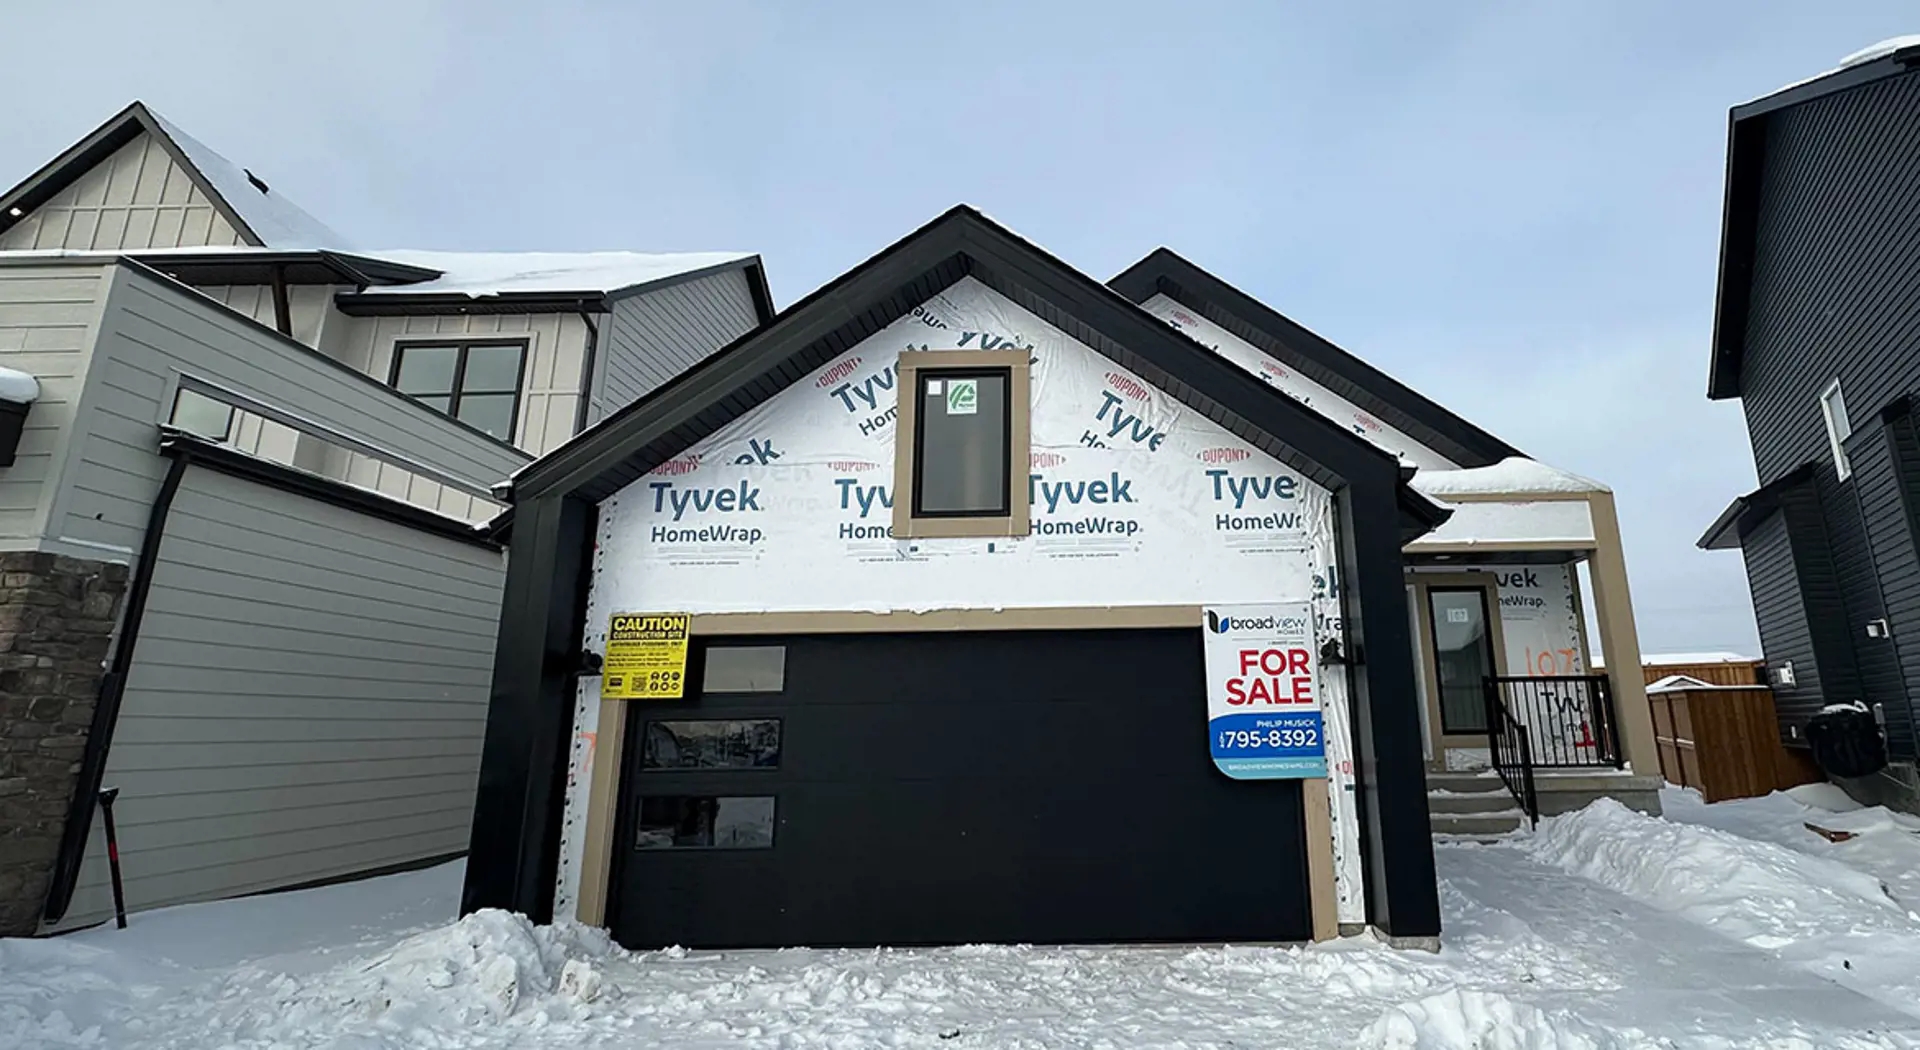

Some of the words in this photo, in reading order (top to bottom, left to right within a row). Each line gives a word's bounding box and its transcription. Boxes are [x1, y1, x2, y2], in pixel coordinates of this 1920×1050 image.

[820, 358, 858, 387] DUPONT
[830, 360, 899, 412] Tyv
[1109, 373, 1148, 401] DUPONT
[1202, 448, 1245, 463] DUPONT
[649, 480, 760, 521] Tyvek
[1029, 472, 1133, 514] Tyvek
[651, 525, 762, 545] HomeWrap
[1029, 517, 1138, 537] HomeWrap
[613, 617, 685, 631] CAUTION
[1230, 615, 1306, 630] broadview
[613, 631, 666, 639] CONSTRUCTION
[667, 631, 683, 639] SITE
[1239, 648, 1311, 677] FOR
[1226, 677, 1313, 706] SALE
[1256, 719, 1281, 728] PHILIP
[1284, 718, 1316, 727] MUSICK
[1225, 728, 1317, 749] 795-8392
